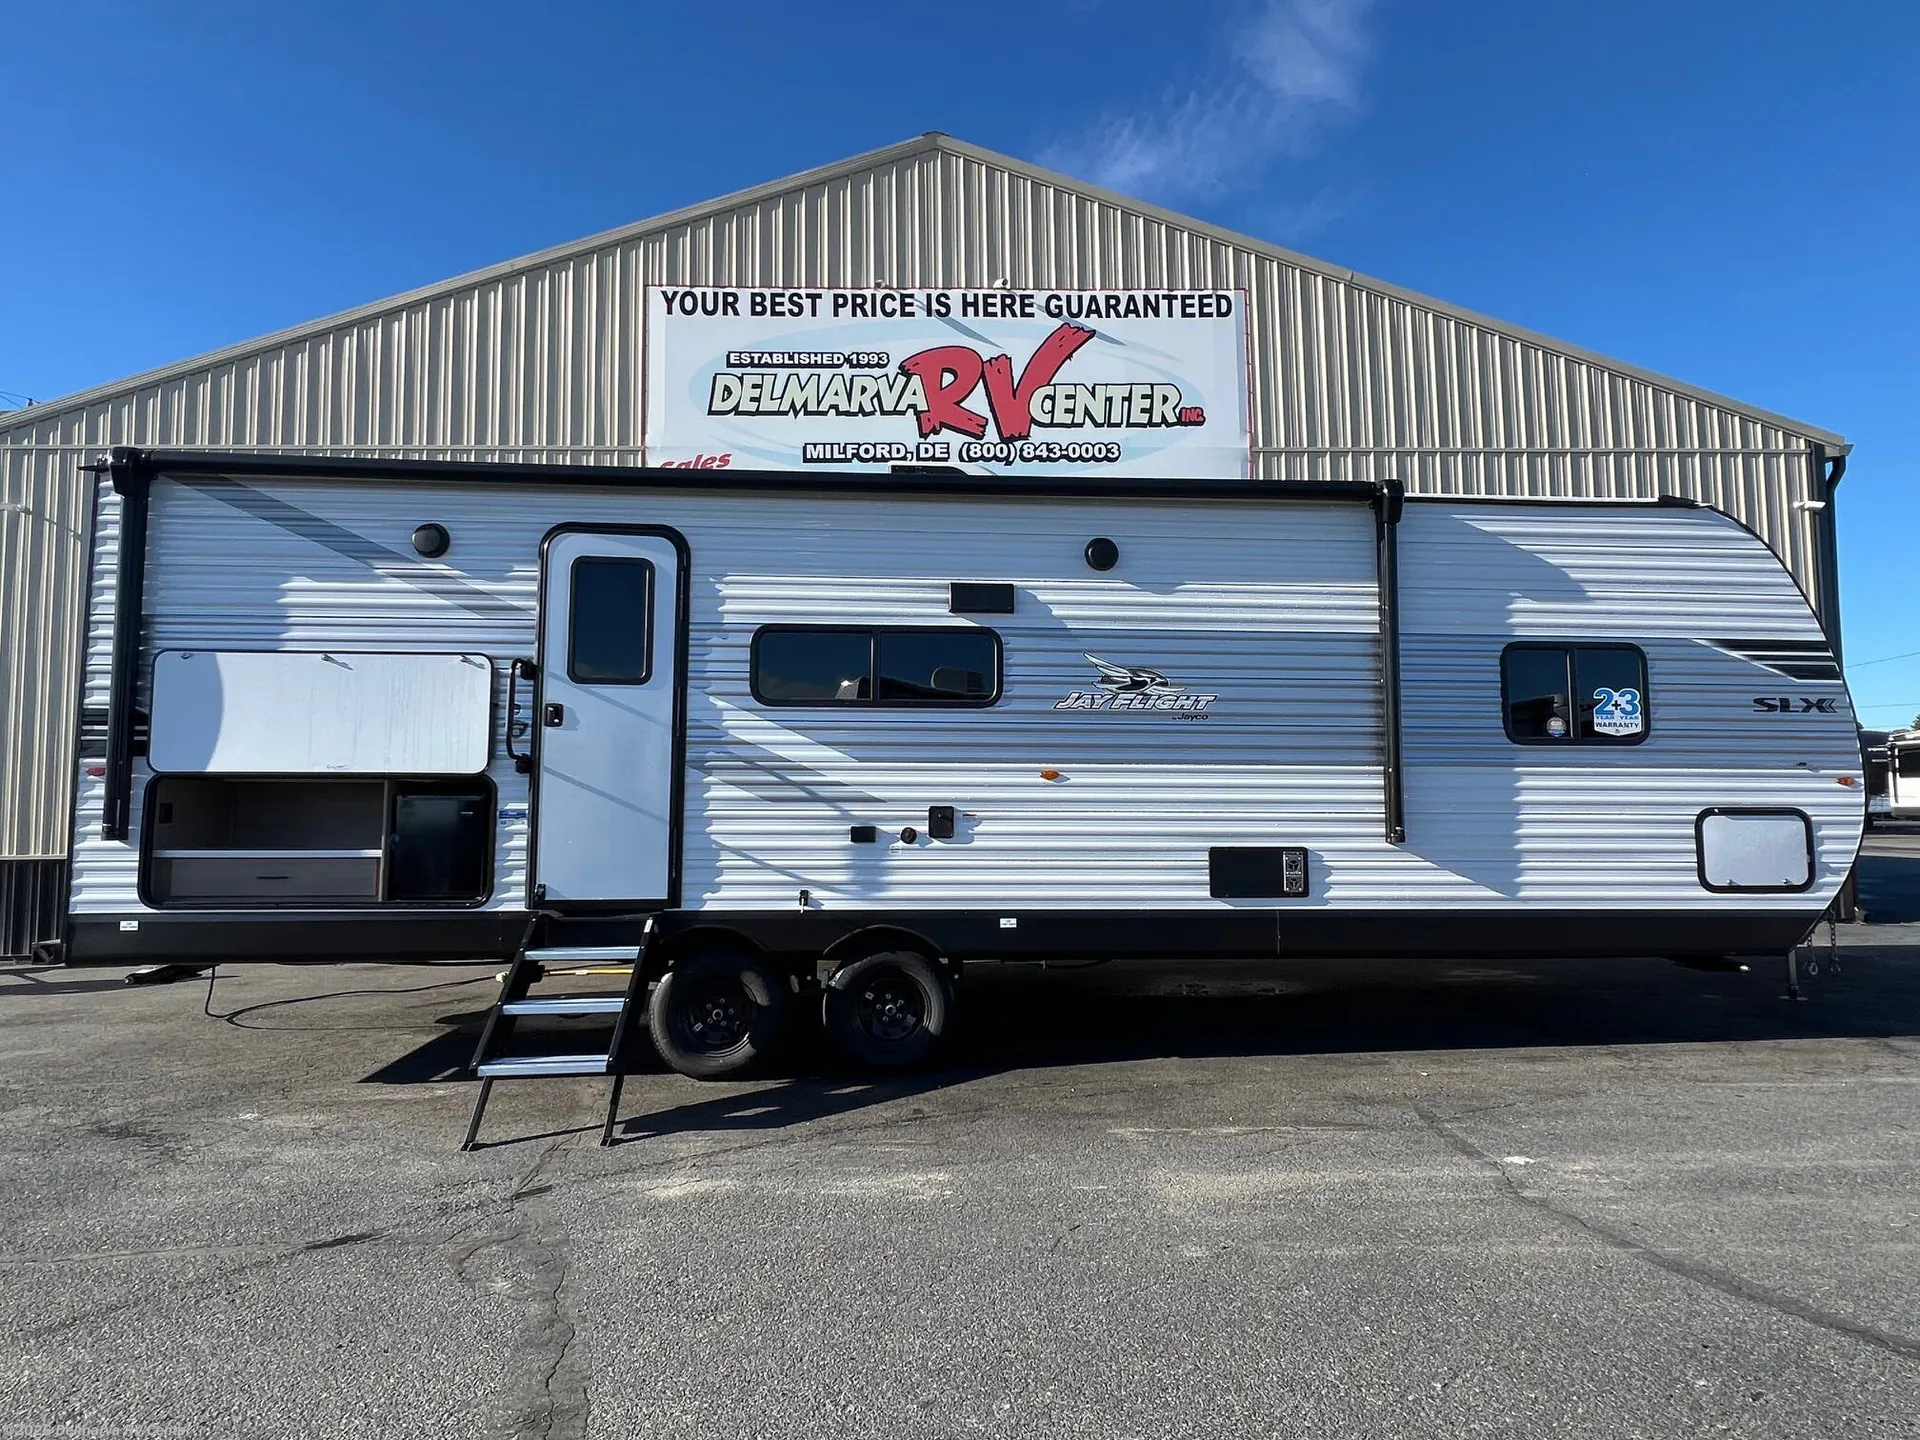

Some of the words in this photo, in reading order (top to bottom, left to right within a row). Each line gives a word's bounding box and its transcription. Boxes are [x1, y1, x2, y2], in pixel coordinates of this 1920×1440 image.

[661, 291, 740, 317] YOUR
[750, 293, 822, 318] BEST
[832, 294, 916, 318] PRICE
[925, 294, 951, 318] IS
[962, 294, 1035, 318] HERE
[1045, 295, 1232, 318] GUARANTEED
[728, 352, 844, 367] ESTABLISHED
[849, 352, 890, 368] 1993
[707, 373, 930, 416] DELMARVA
[900, 322, 1096, 440] RV
[1029, 383, 1182, 427] CENTER
[1180, 407, 1205, 423] INC.
[804, 443, 914, 463] MILFORD,
[918, 443, 950, 460] DE
[960, 443, 1016, 465] (800)
[1021, 443, 1121, 462] 843-0003
[1053, 692, 1111, 710] JAY
[1109, 693, 1218, 711] FLIGHT
[1752, 697, 1838, 714] SLX
[1177, 712, 1209, 722] Jayco
